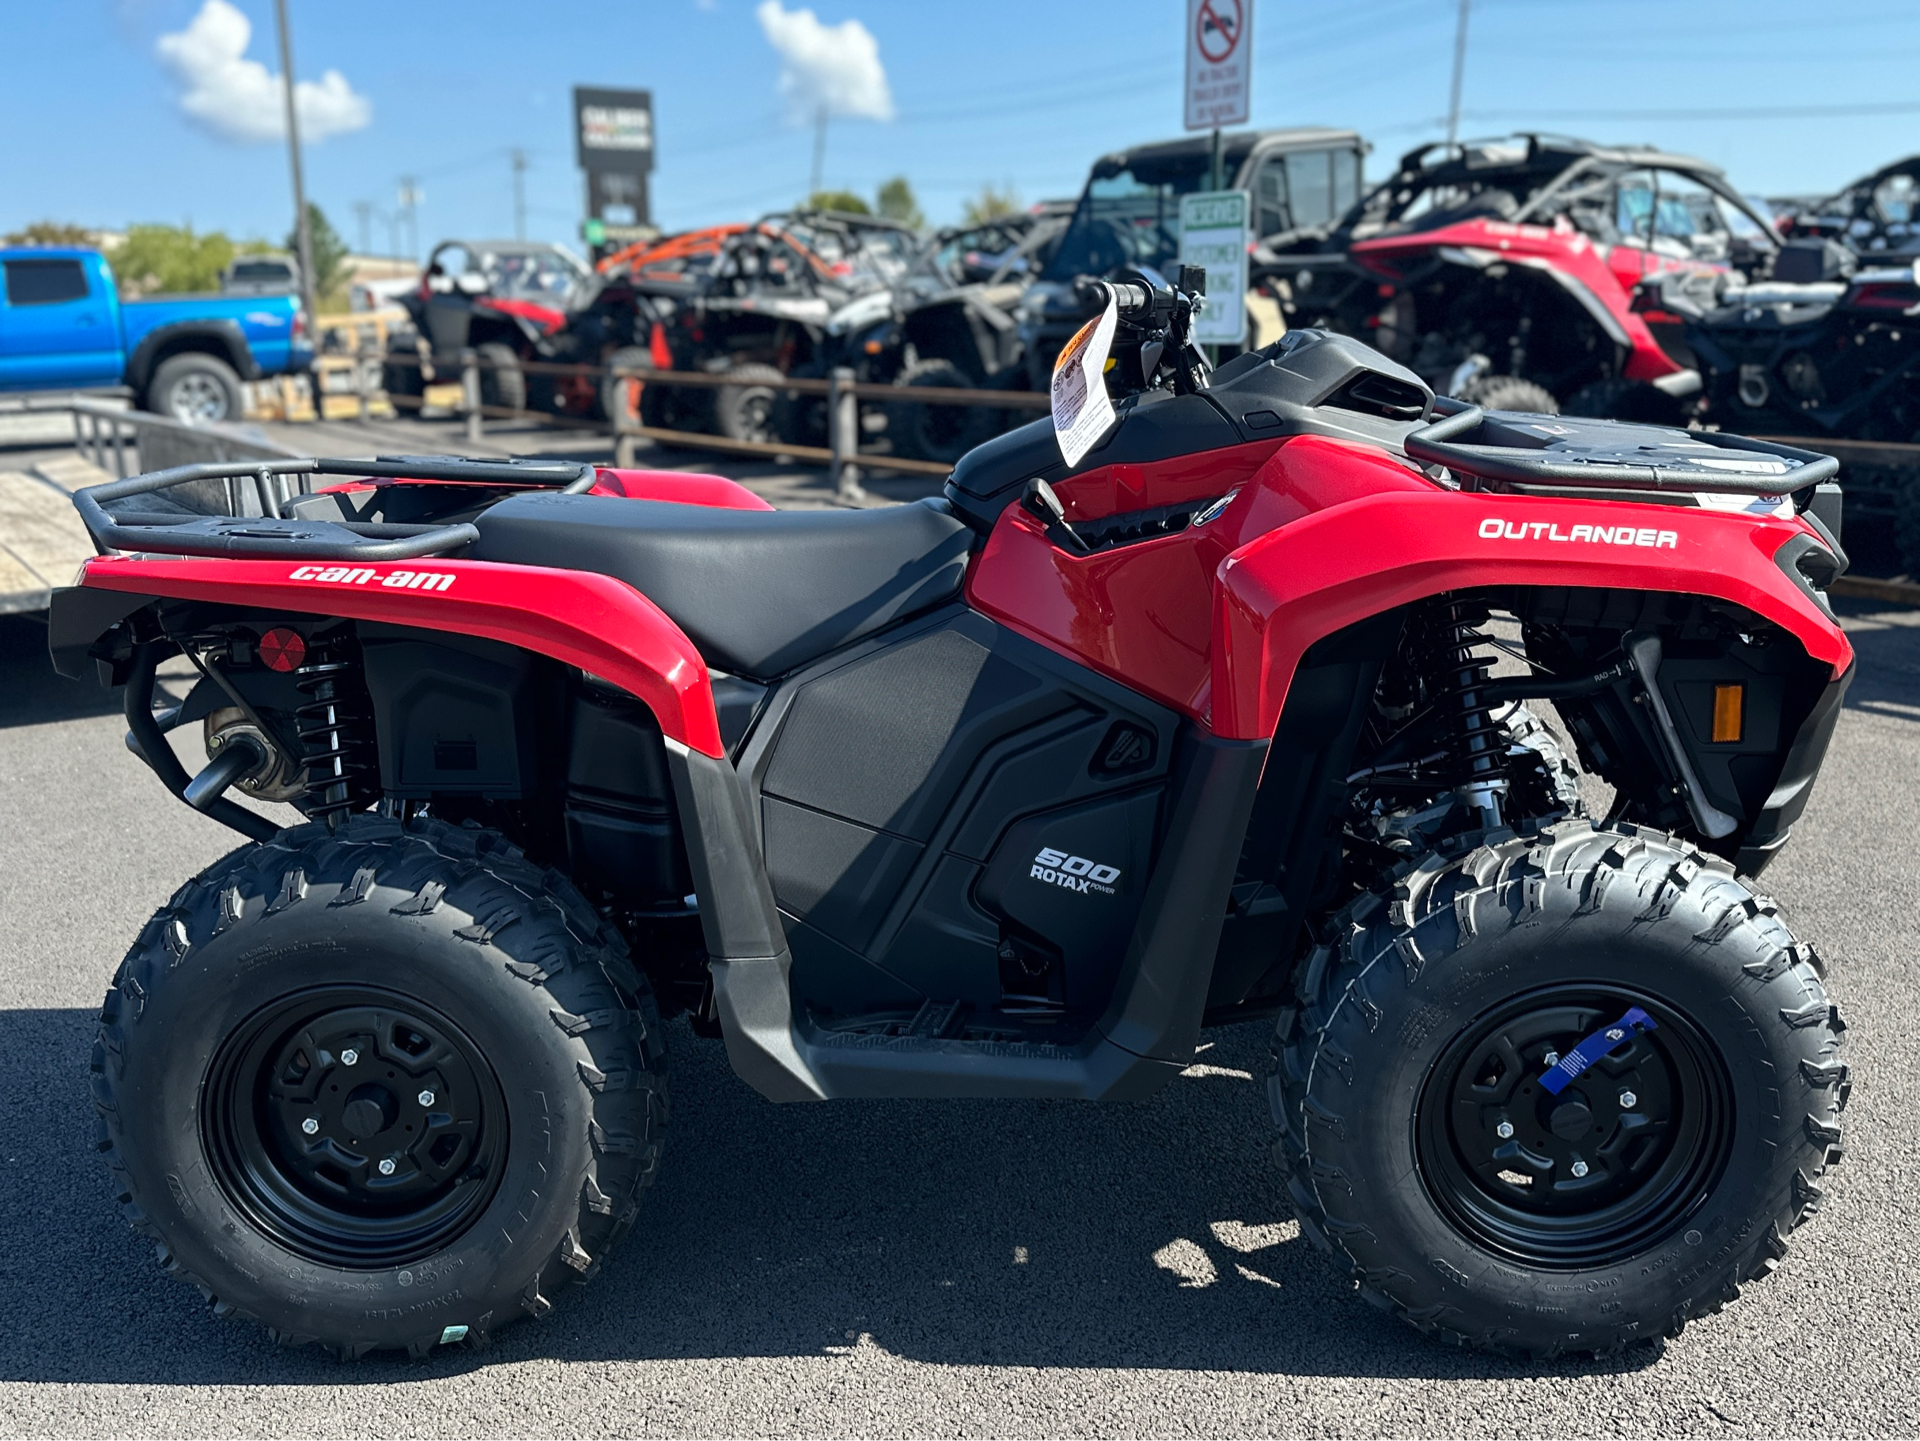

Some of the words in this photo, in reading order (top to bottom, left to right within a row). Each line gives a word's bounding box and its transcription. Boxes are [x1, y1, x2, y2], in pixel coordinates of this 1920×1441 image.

[1186, 200, 1240, 225] RESERVED
[1478, 518, 1678, 549] OUTLANDER
[289, 566, 457, 592] can-am
[1594, 671, 1609, 683] RAD
[1030, 865, 1090, 894] ROTAX
[1090, 882, 1115, 895] POWER
[1034, 847, 1121, 885] 500
